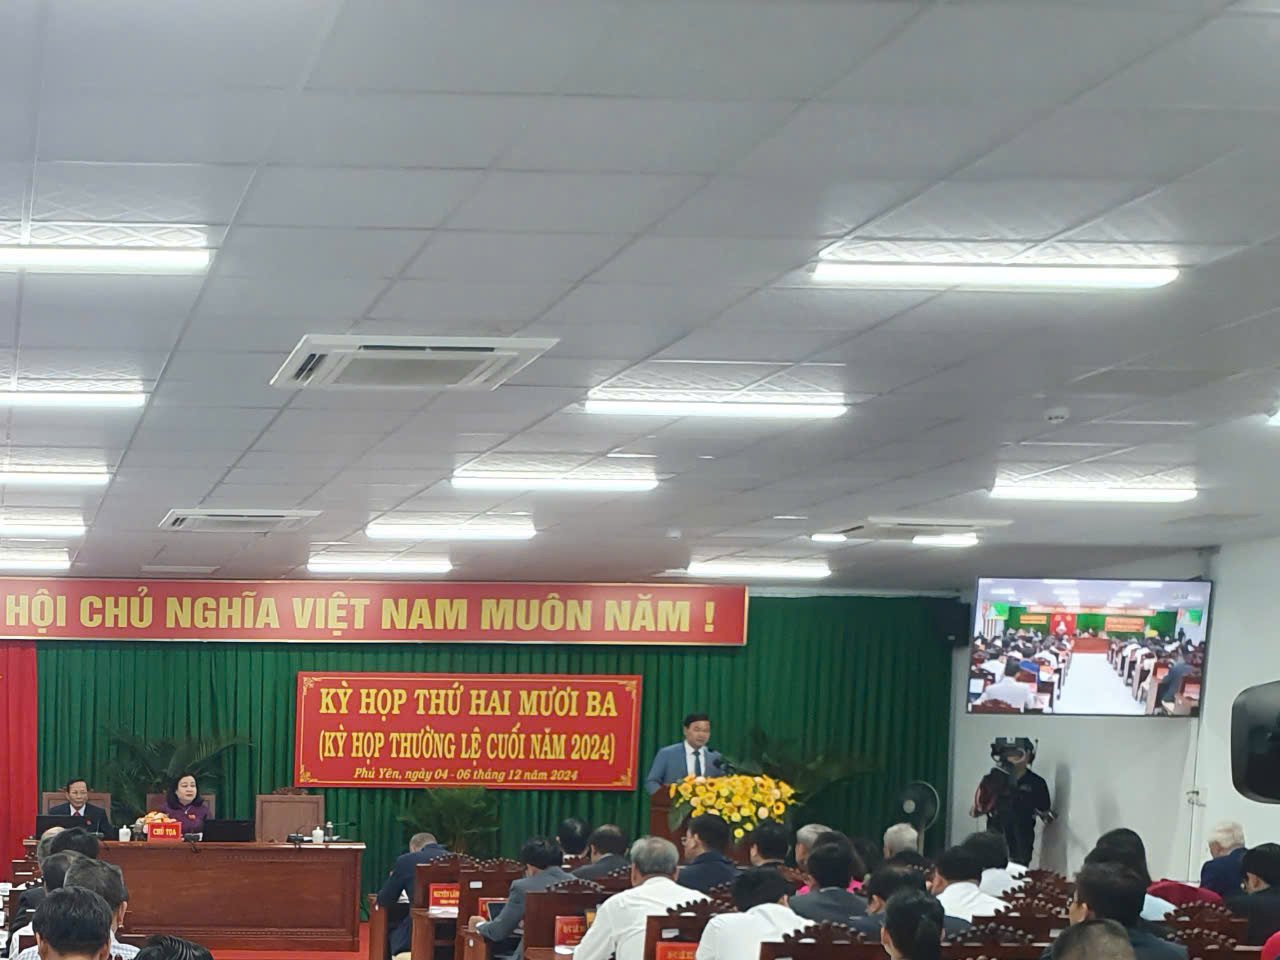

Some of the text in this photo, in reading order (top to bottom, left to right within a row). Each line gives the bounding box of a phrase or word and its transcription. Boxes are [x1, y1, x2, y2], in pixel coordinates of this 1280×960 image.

[5, 587, 67, 634] HỘI
[79, 586, 153, 629] CHỦ
[166, 590, 280, 630] NGHĨA
[292, 591, 370, 636] VIỆT
[381, 598, 468, 630] NAM
[481, 593, 593, 631] MUÔN
[604, 592, 691, 632] NĂM
[704, 601, 715, 633] !
[319, 680, 618, 722] KỲ HỌP THỨ HAI MƯƠI BA
[319, 722, 616, 766] (KỲ HỌP THƯỜNG LỆ CUỐI NĂM 2024)
[378, 767, 402, 781] Yên,
[405, 768, 432, 782] ngày
[434, 768, 449, 780] 04
[456, 769, 471, 780] 06
[473, 769, 506, 782] tháng
[508, 769, 522, 780] 12
[524, 769, 548, 781] năm
[550, 769, 579, 781] 2024
